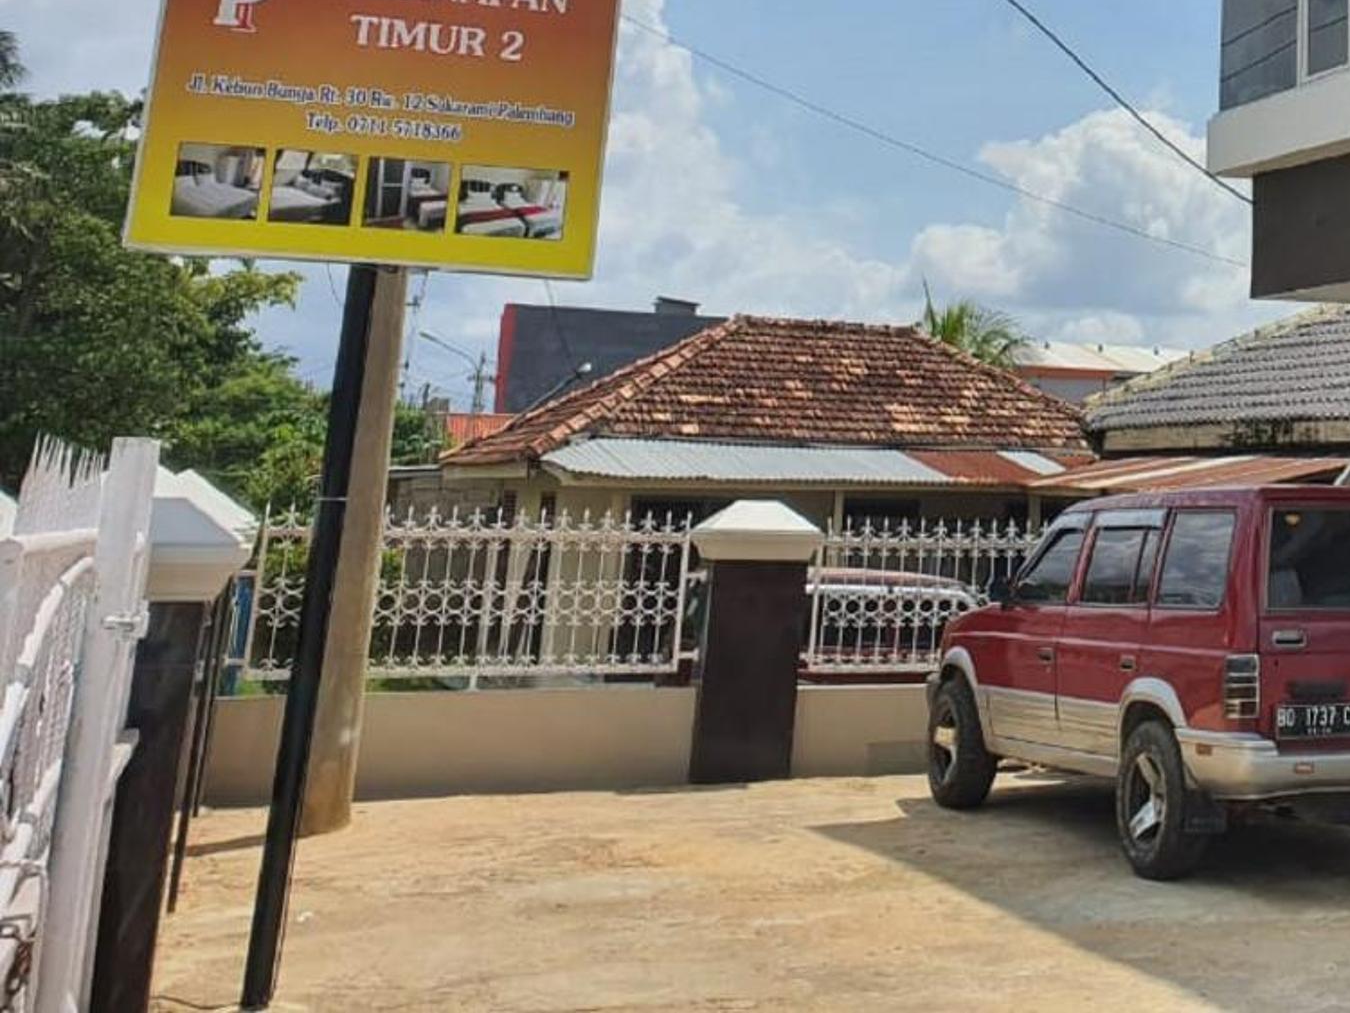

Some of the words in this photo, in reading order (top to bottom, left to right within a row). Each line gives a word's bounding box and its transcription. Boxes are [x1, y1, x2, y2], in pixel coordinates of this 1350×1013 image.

[350, 14, 485, 56] TIMUR
[499, 32, 525, 61] 2
[211, 75, 266, 100] Kebun
[344, 87, 368, 107] 30
[402, 92, 424, 112] 12
[1306, 705, 1336, 727] 1737
